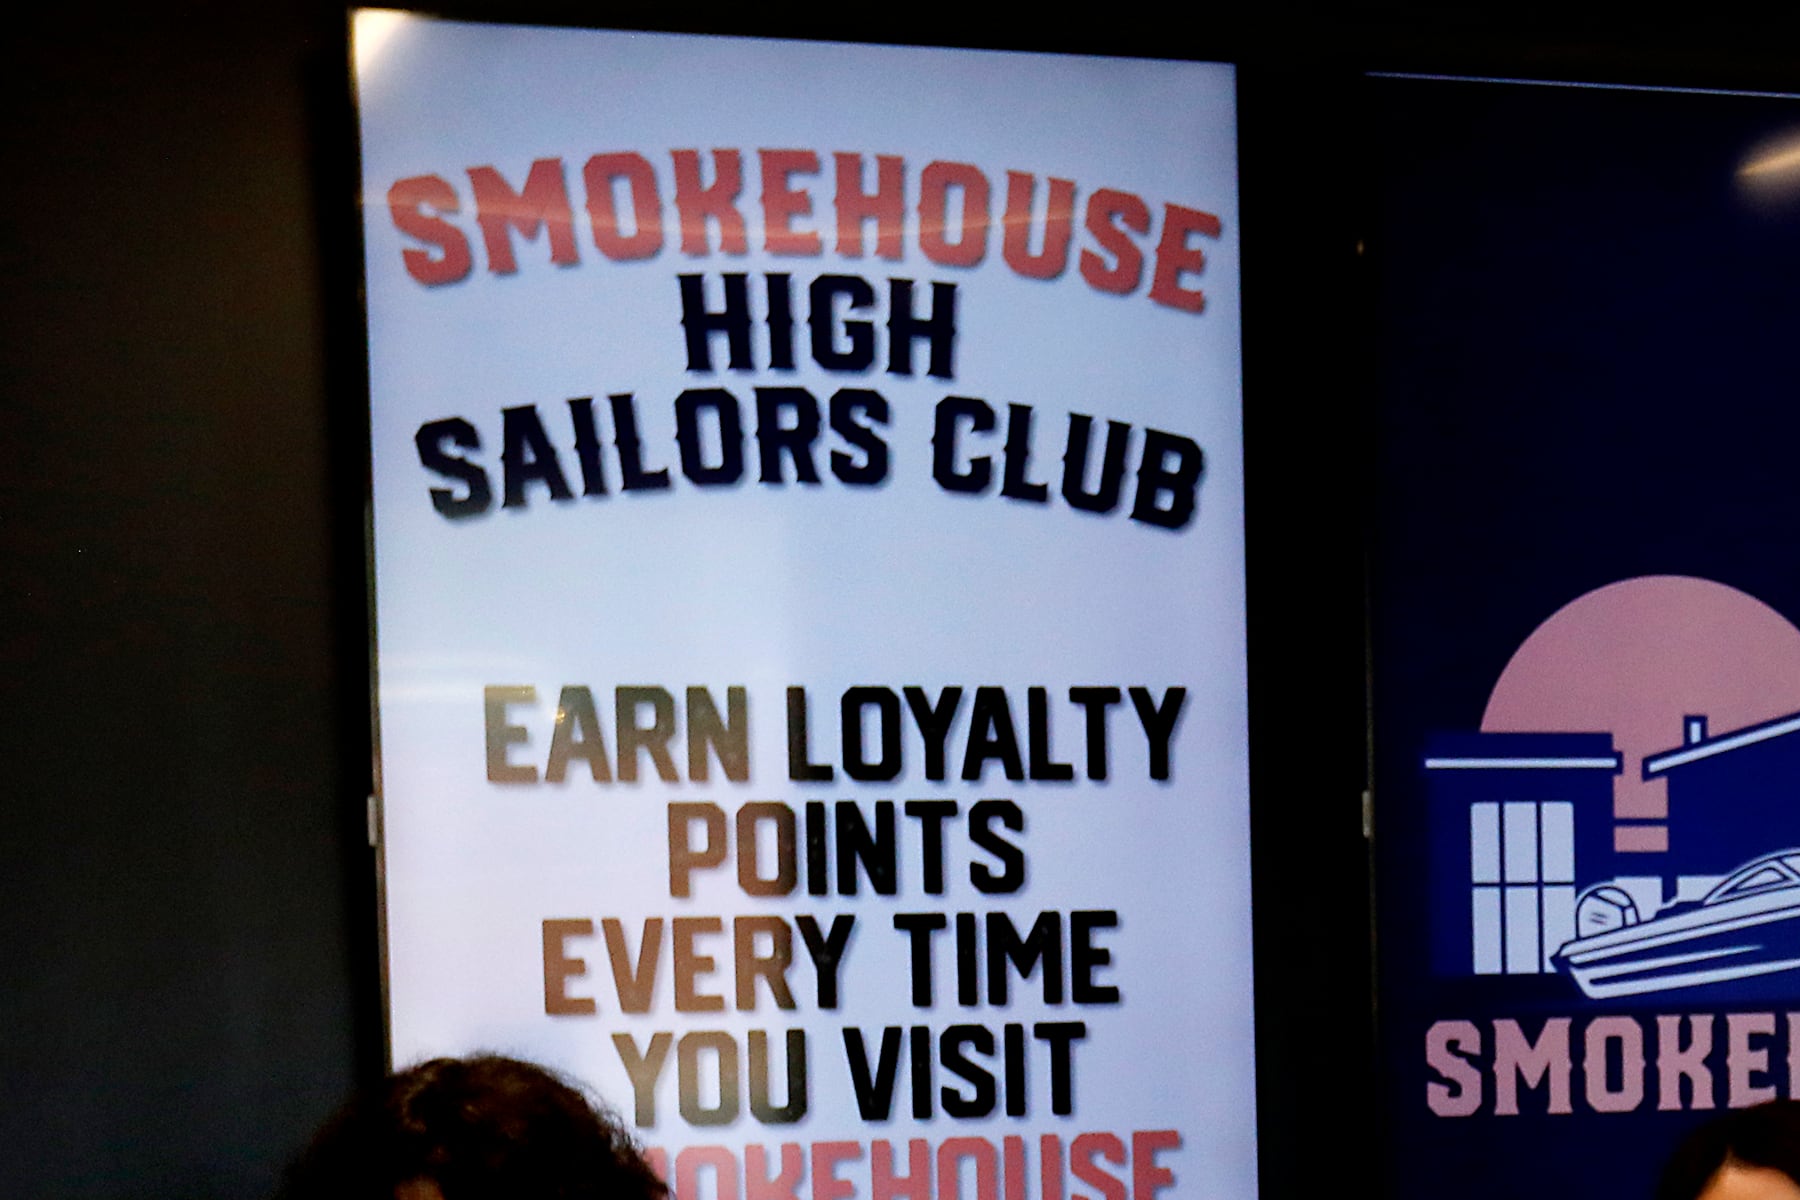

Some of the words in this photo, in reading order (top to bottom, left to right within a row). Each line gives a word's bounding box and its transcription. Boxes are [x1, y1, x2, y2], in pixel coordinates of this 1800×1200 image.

[386, 149, 1221, 313] SMOKEHOUSE
[677, 272, 960, 379] HIGH
[415, 387, 890, 521] SAILORS
[931, 395, 1207, 531] CLUB
[484, 685, 749, 783] EARN
[787, 686, 1187, 782] LOYALTY
[667, 800, 1026, 898] POINTS
[542, 914, 856, 1015] EVERY
[893, 910, 1120, 1007] TIME
[611, 1030, 807, 1127] YOU
[842, 1022, 1086, 1121] VISIT
